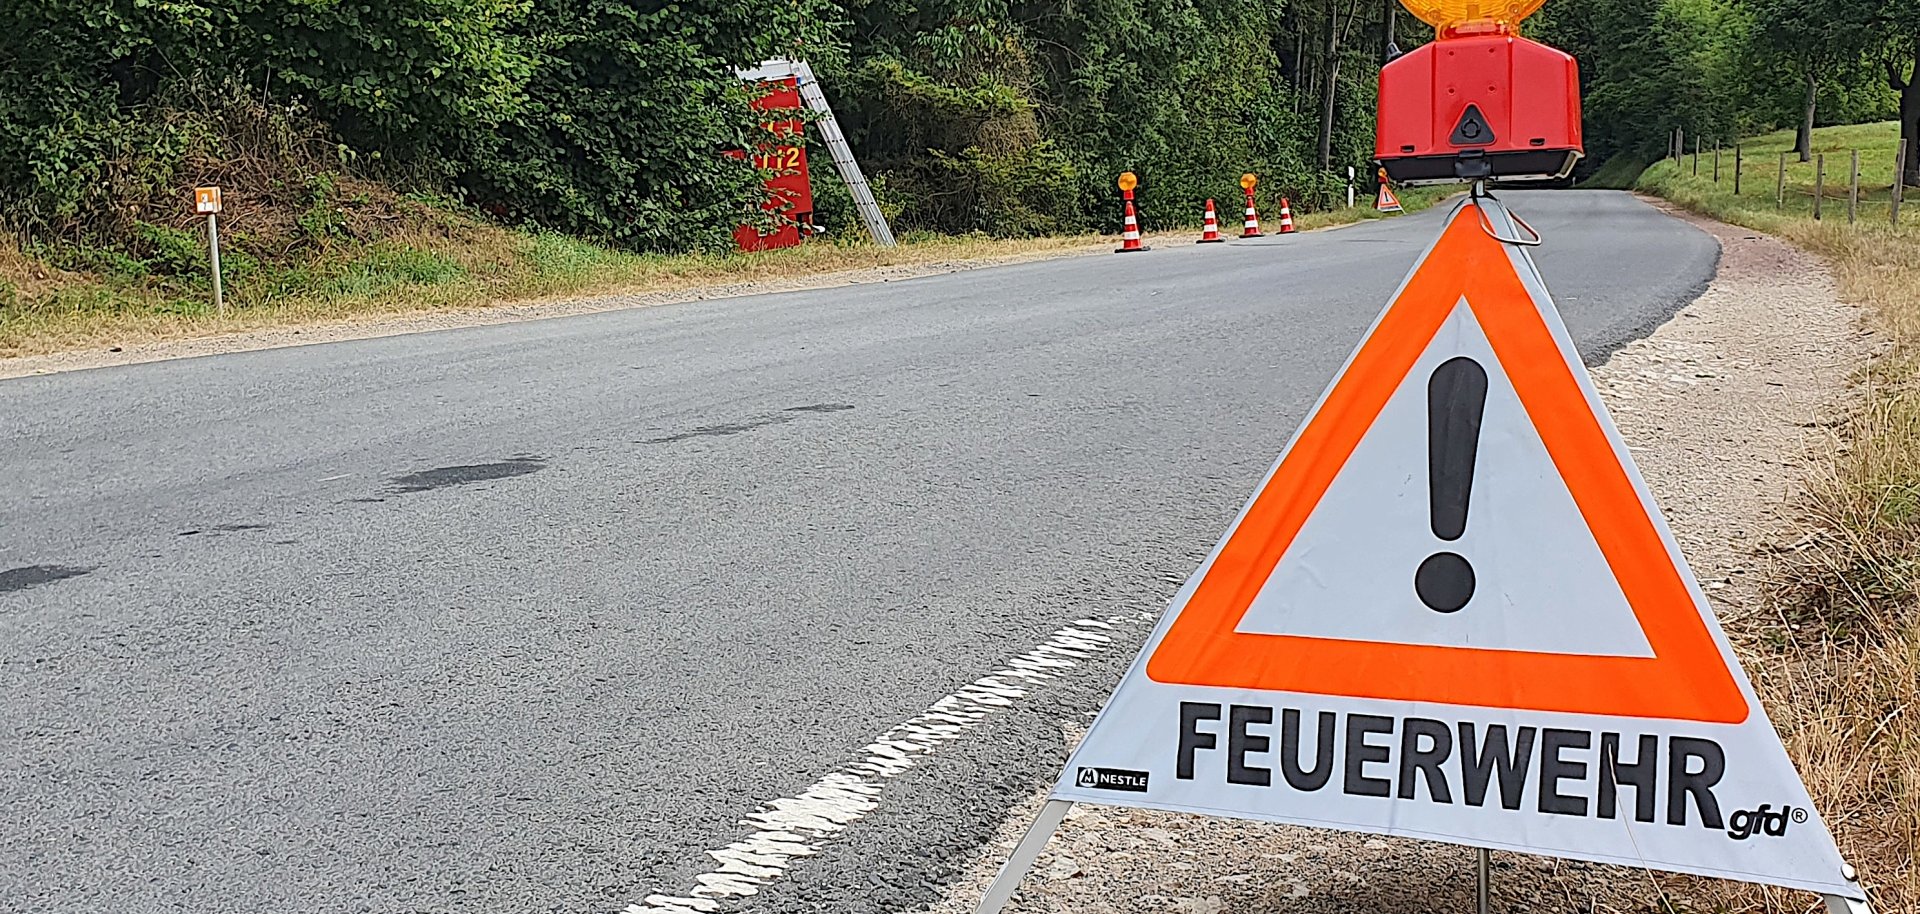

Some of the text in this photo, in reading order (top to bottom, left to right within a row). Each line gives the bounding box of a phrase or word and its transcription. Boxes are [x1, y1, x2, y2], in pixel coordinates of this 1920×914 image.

[762, 147, 800, 169] 112
[1176, 701, 1725, 830] FEUERWEHR
[1100, 773, 1147, 787] NESTLE
